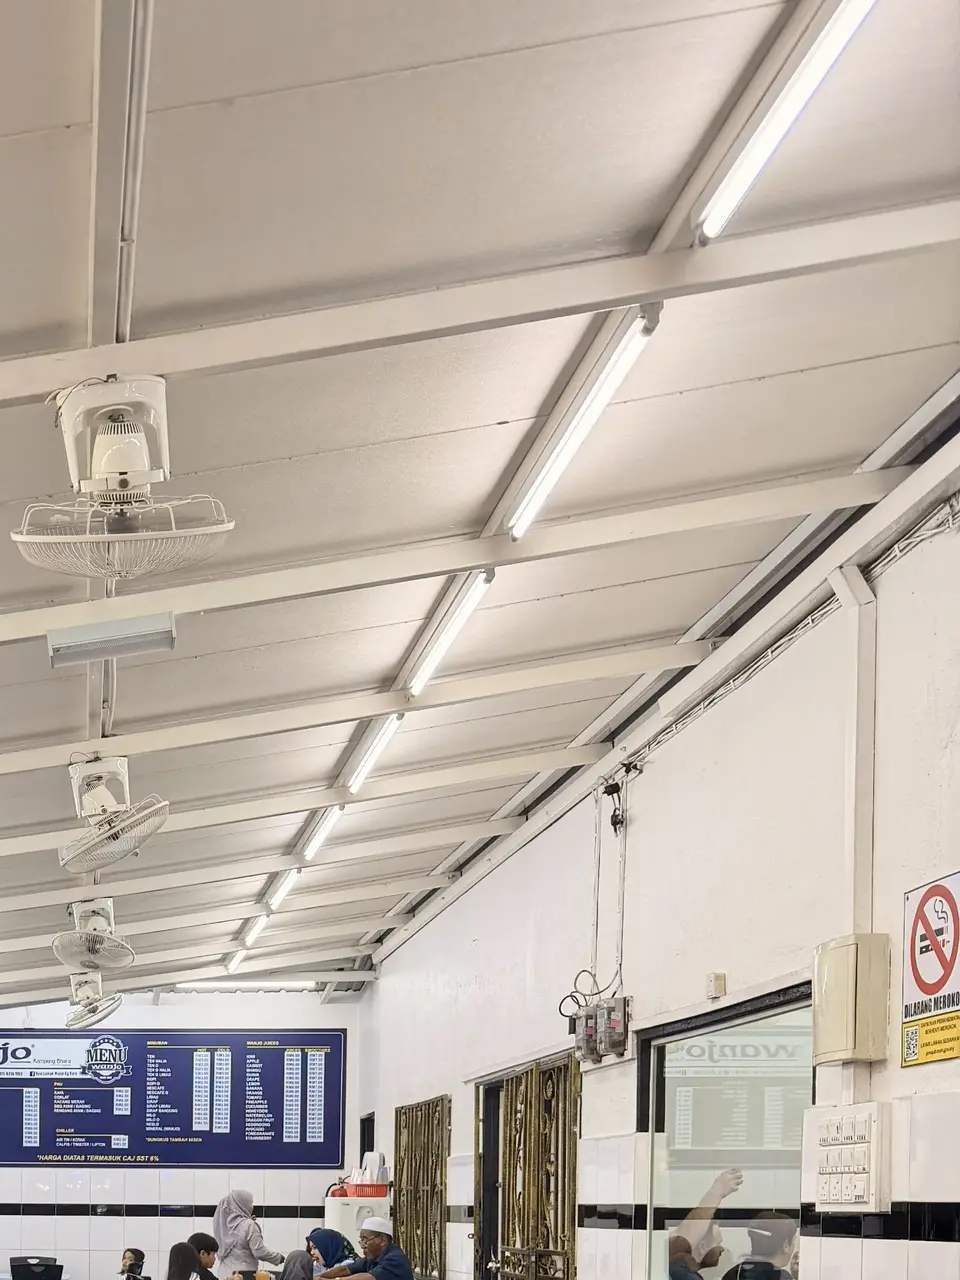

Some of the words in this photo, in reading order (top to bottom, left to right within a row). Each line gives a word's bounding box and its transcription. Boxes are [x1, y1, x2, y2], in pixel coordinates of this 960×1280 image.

[904, 998, 932, 1018] DILARANG
[933, 991, 960, 1011] MEROKO
[87, 1047, 127, 1063] MENU
